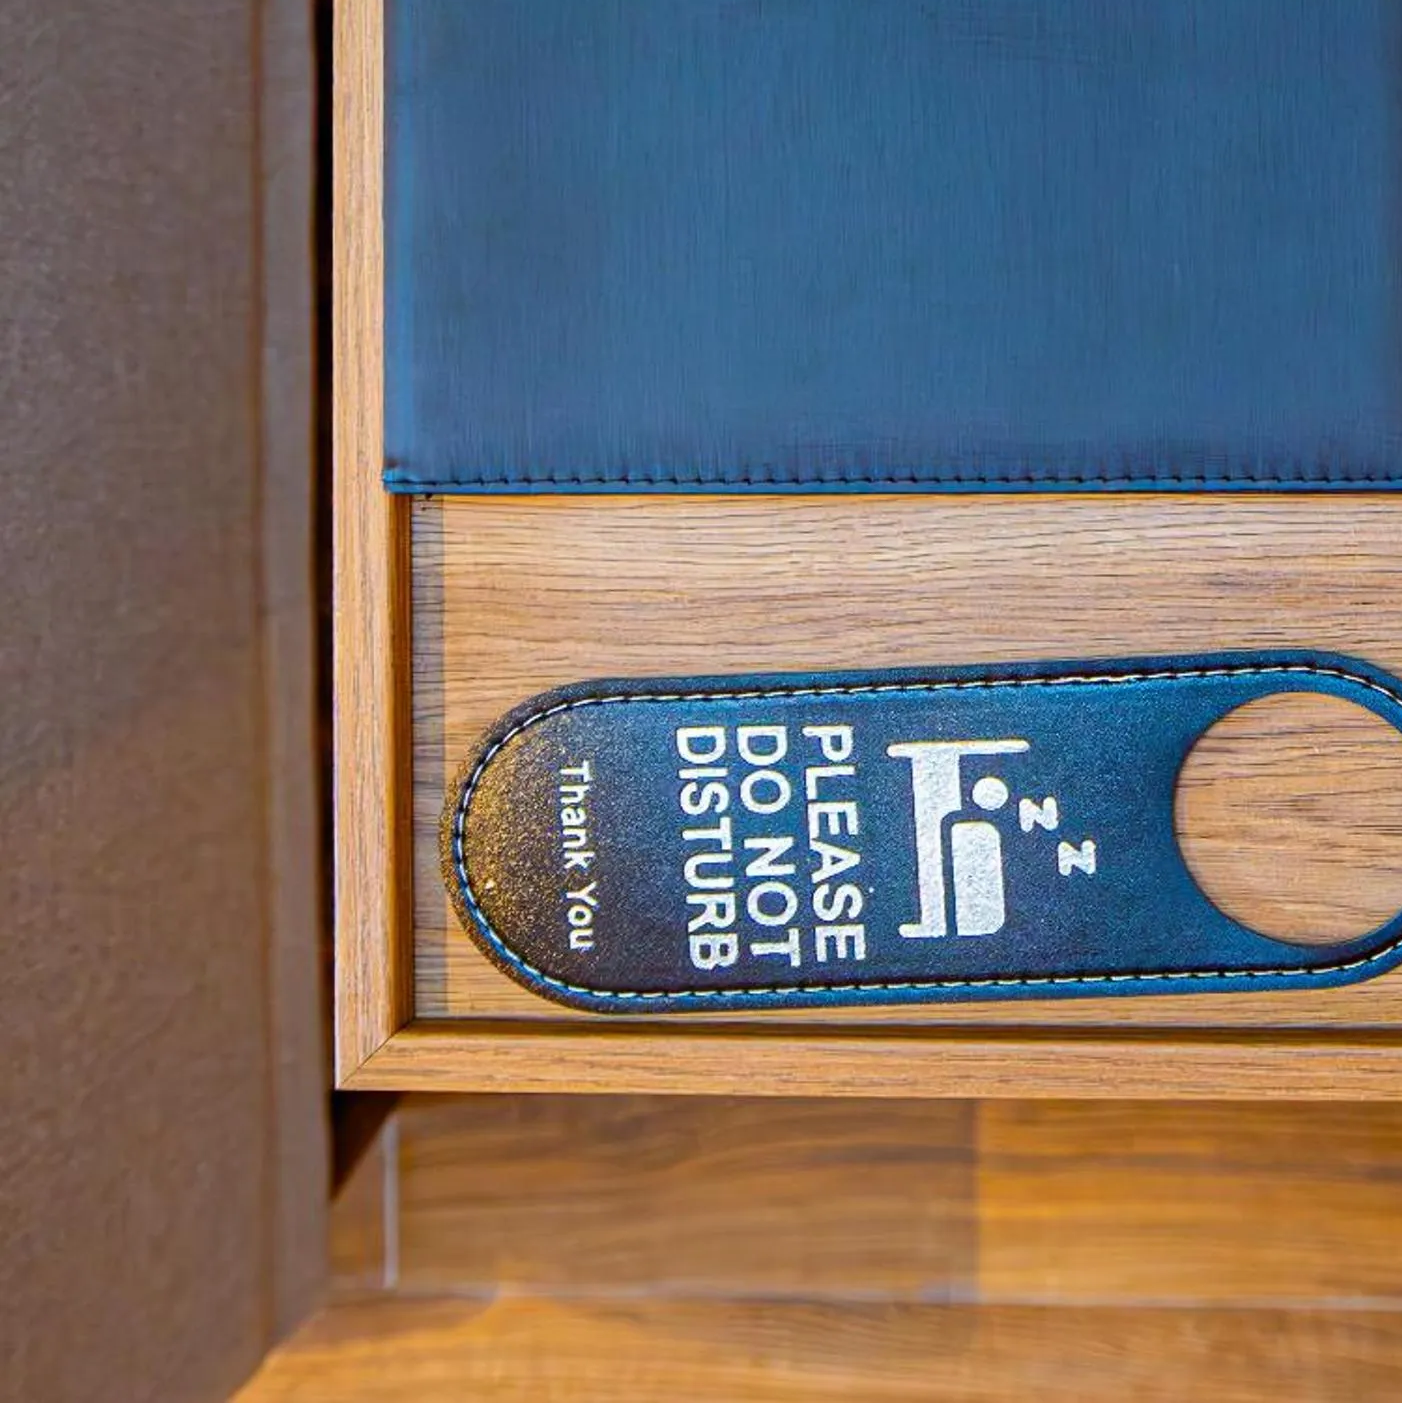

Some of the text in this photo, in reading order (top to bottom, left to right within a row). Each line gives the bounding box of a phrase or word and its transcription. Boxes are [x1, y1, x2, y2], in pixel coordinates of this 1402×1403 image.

[557, 761, 595, 951] Thank You
[676, 726, 738, 971] DISTURB
[738, 725, 800, 967] DO NOT
[802, 724, 866, 963] PLEASE
